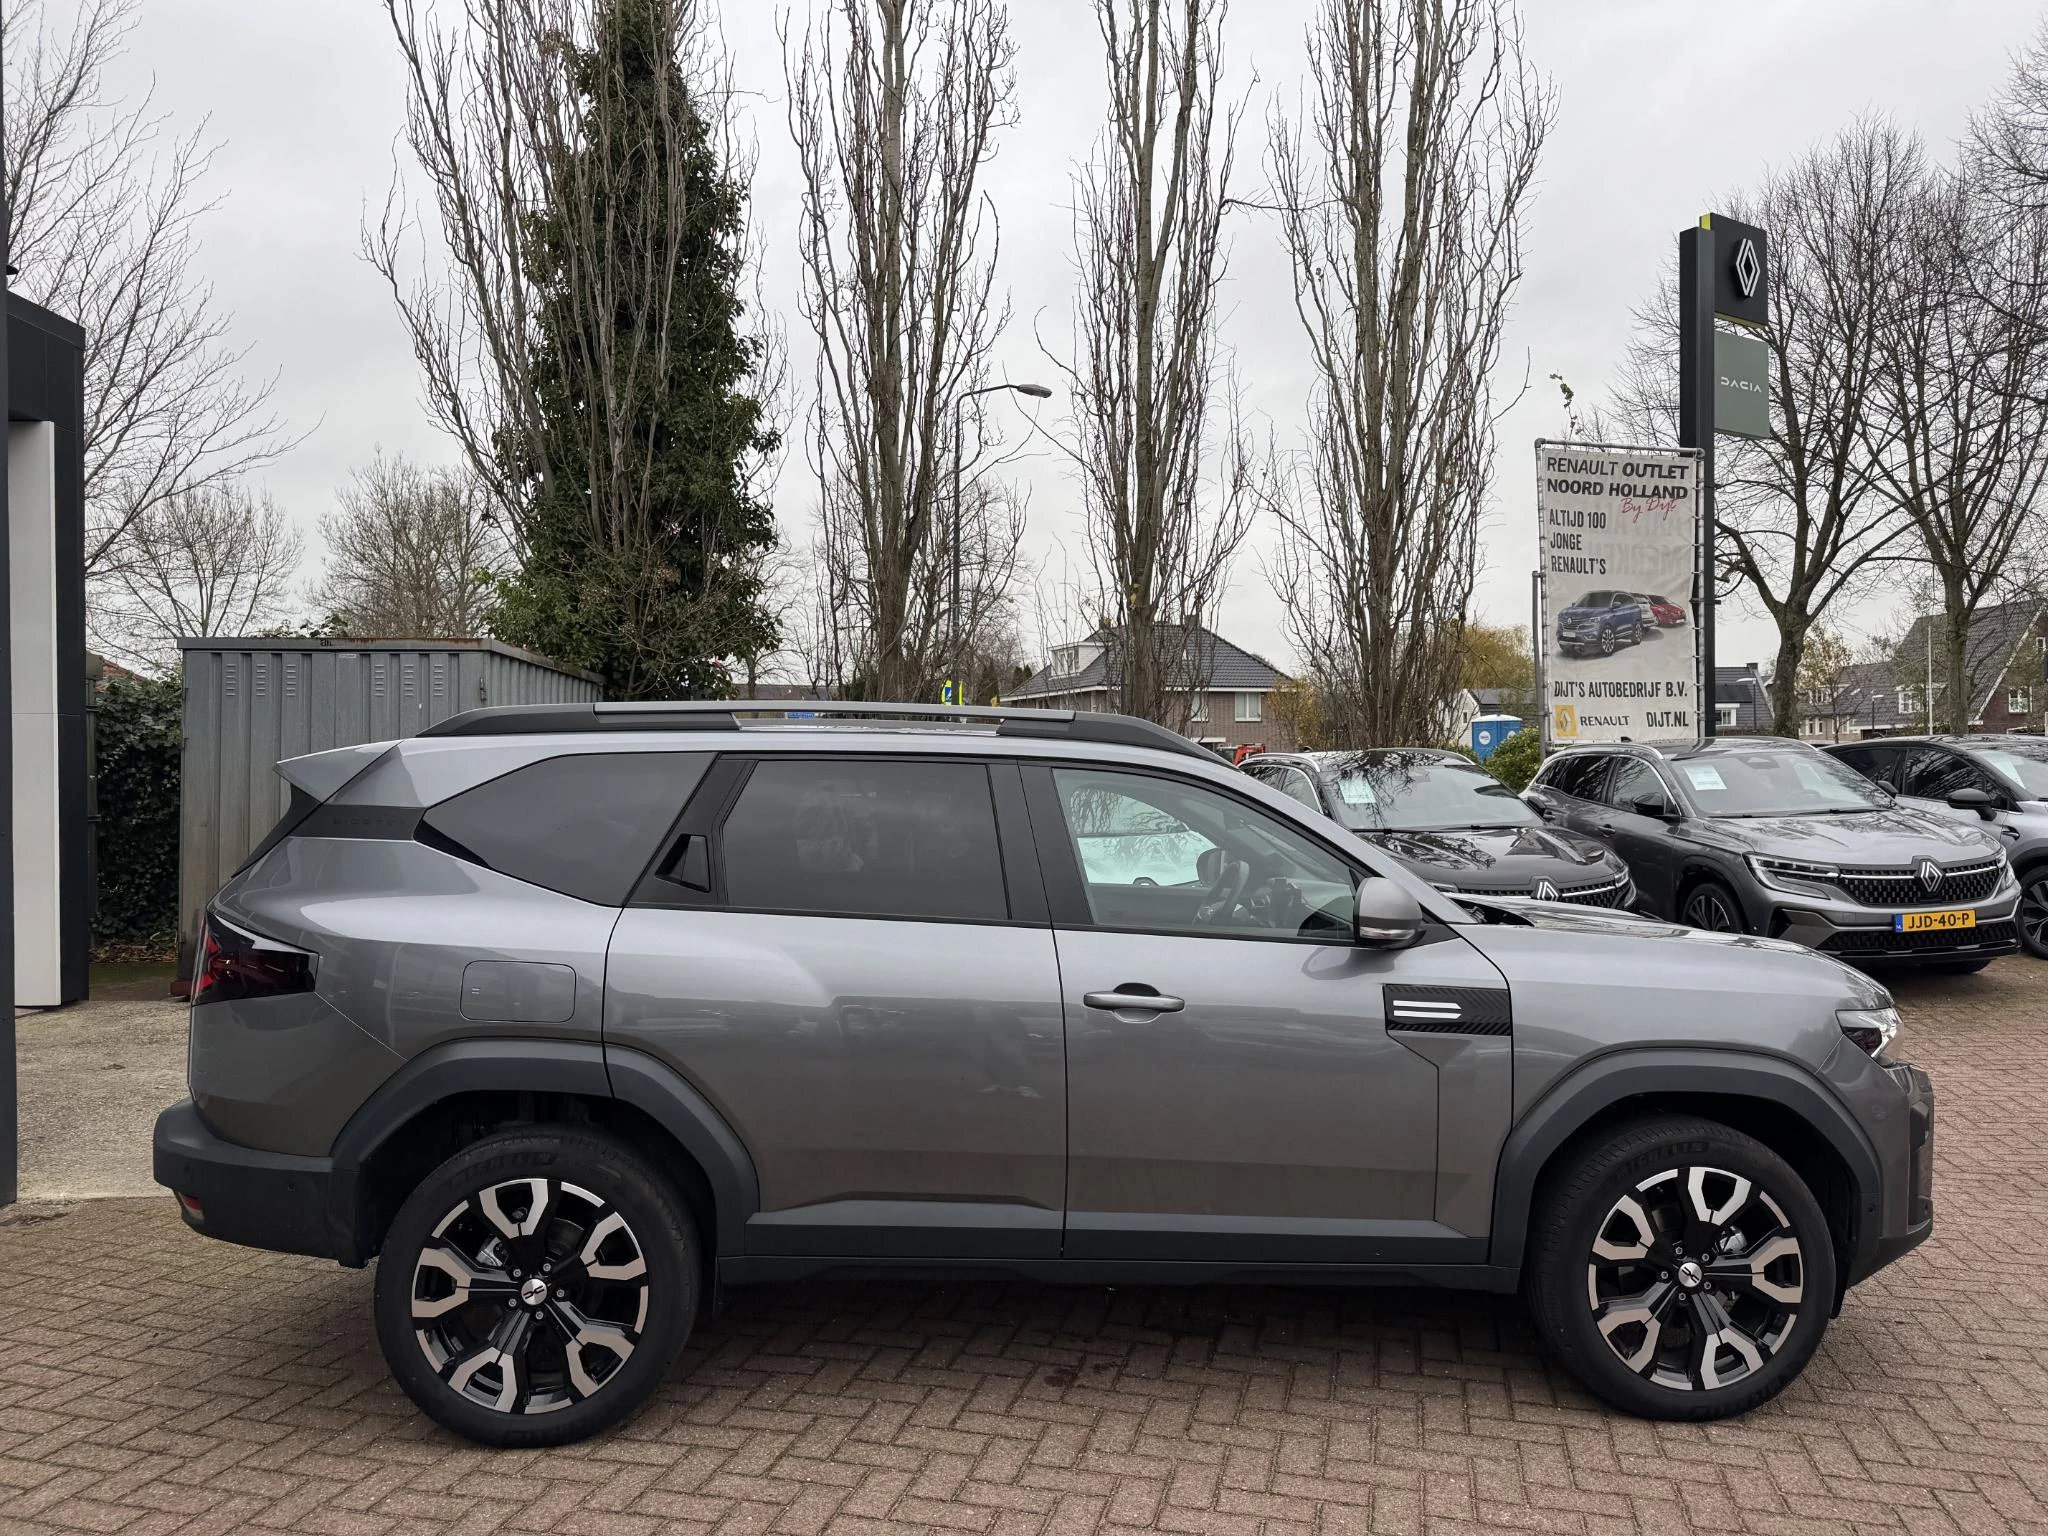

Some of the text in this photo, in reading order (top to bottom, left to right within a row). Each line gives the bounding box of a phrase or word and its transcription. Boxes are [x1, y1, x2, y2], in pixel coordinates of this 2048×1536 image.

[1721, 376, 1762, 393] DACIA
[1547, 457, 1689, 479] RENAULT OUTLET
[1547, 478, 1688, 499] NOORD HOLLAND
[1549, 509, 1584, 528] ALTIJD
[1588, 511, 1606, 529] 100
[1621, 497, 1642, 523] By
[1550, 532, 1582, 550] JONGE
[1551, 555, 1606, 575] RENAULT'S
[1554, 681, 1688, 698] DIJT'S AUTOBEDRIJF B.V.
[1580, 711, 1689, 727] RENAULT DIJT.NL
[1908, 913, 1970, 928] JJD-40-P
